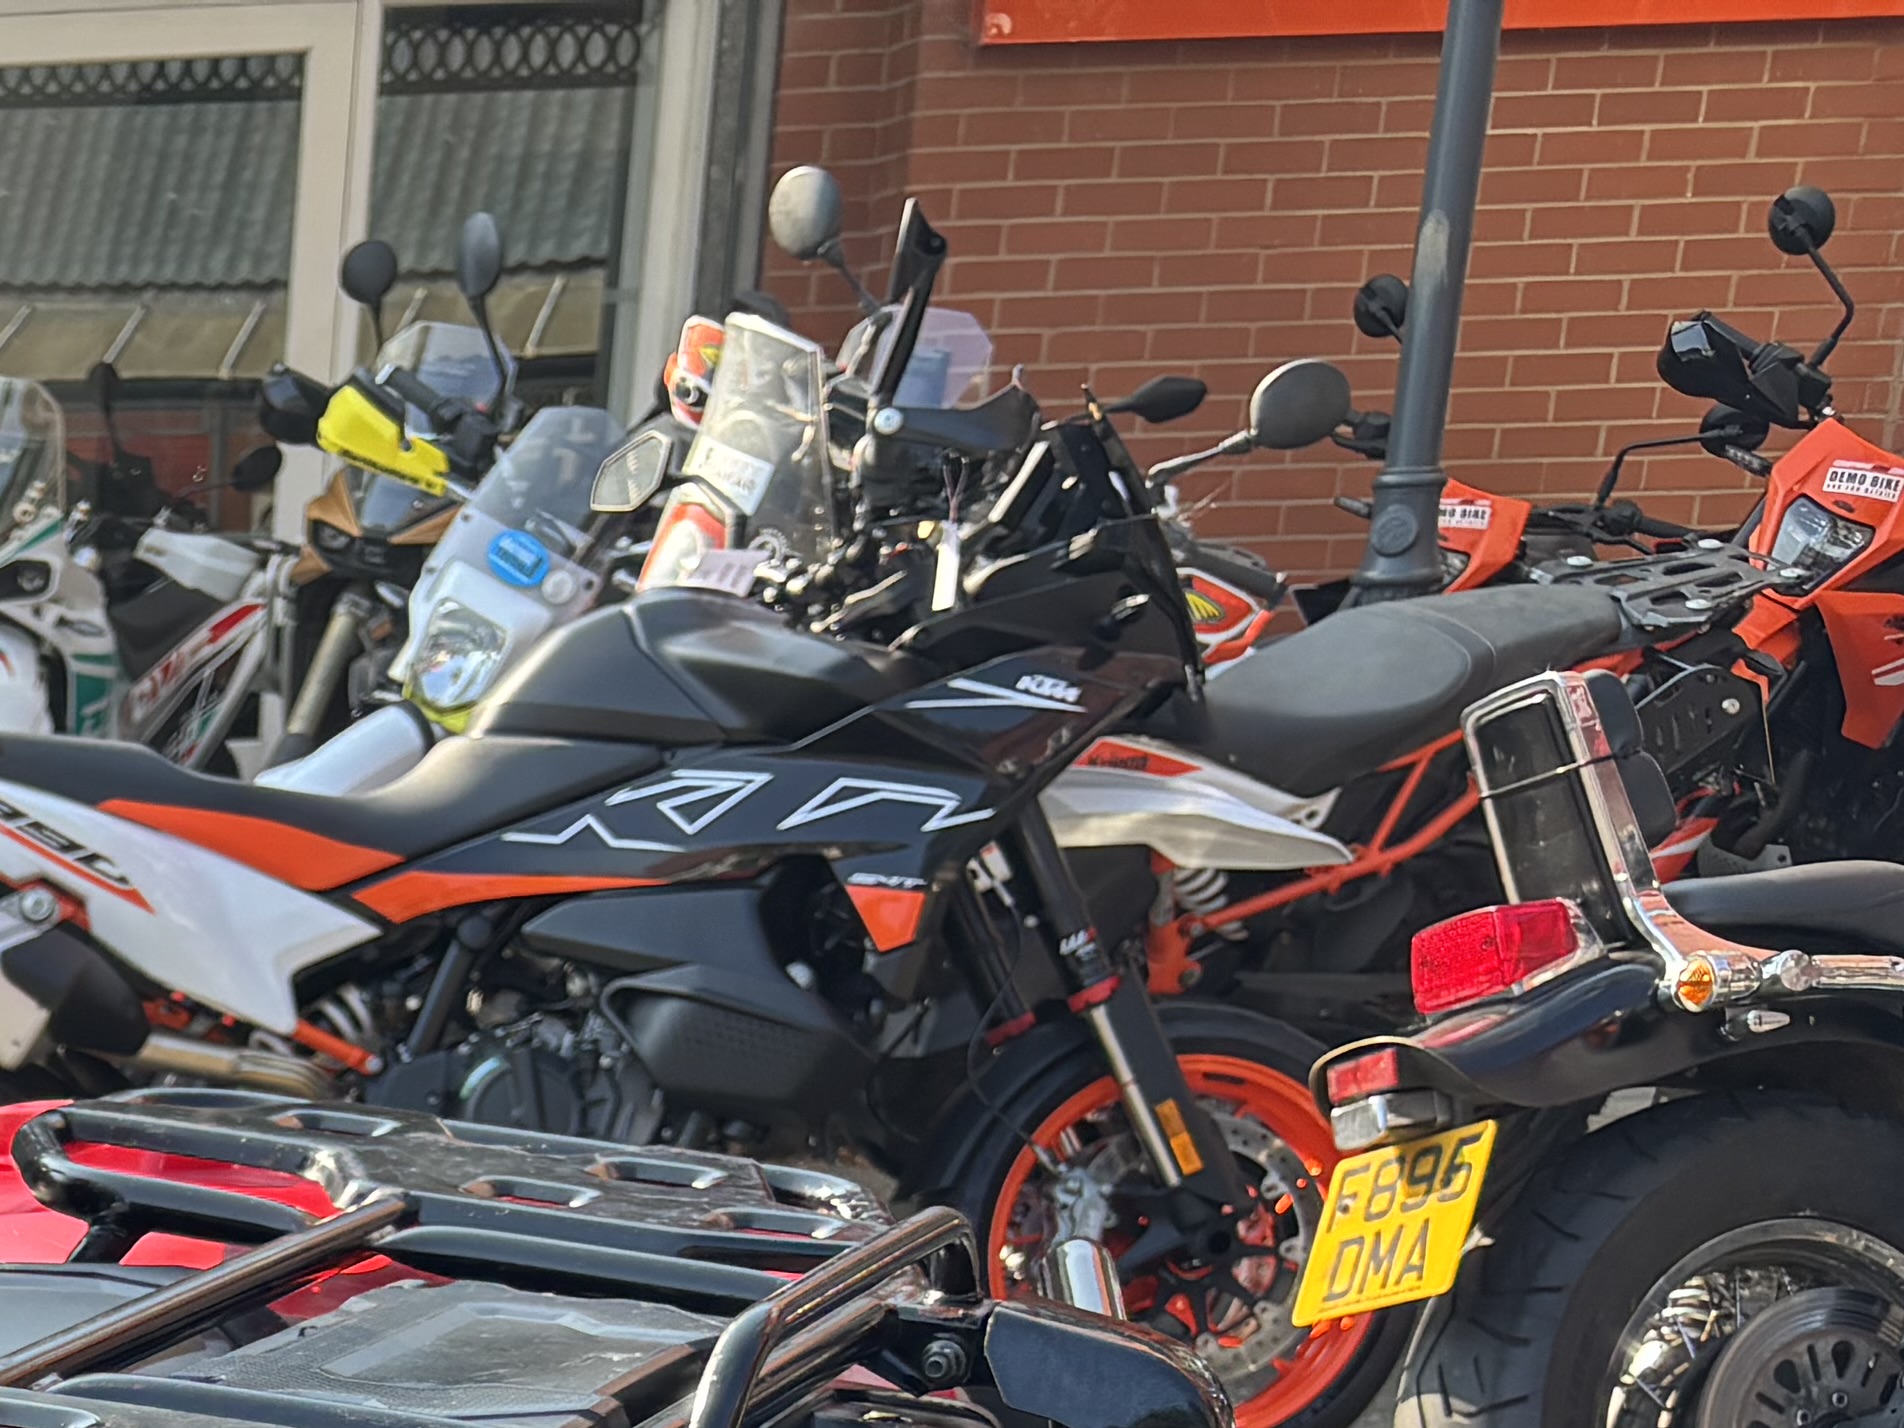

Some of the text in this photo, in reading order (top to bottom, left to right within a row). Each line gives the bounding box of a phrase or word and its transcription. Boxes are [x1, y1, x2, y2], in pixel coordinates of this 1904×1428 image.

[1829, 470, 1867, 486] DEMO
[1870, 475, 1901, 492] BIKE
[1015, 673, 1083, 703] KTM
[1322, 1217, 1430, 1303] DMA
